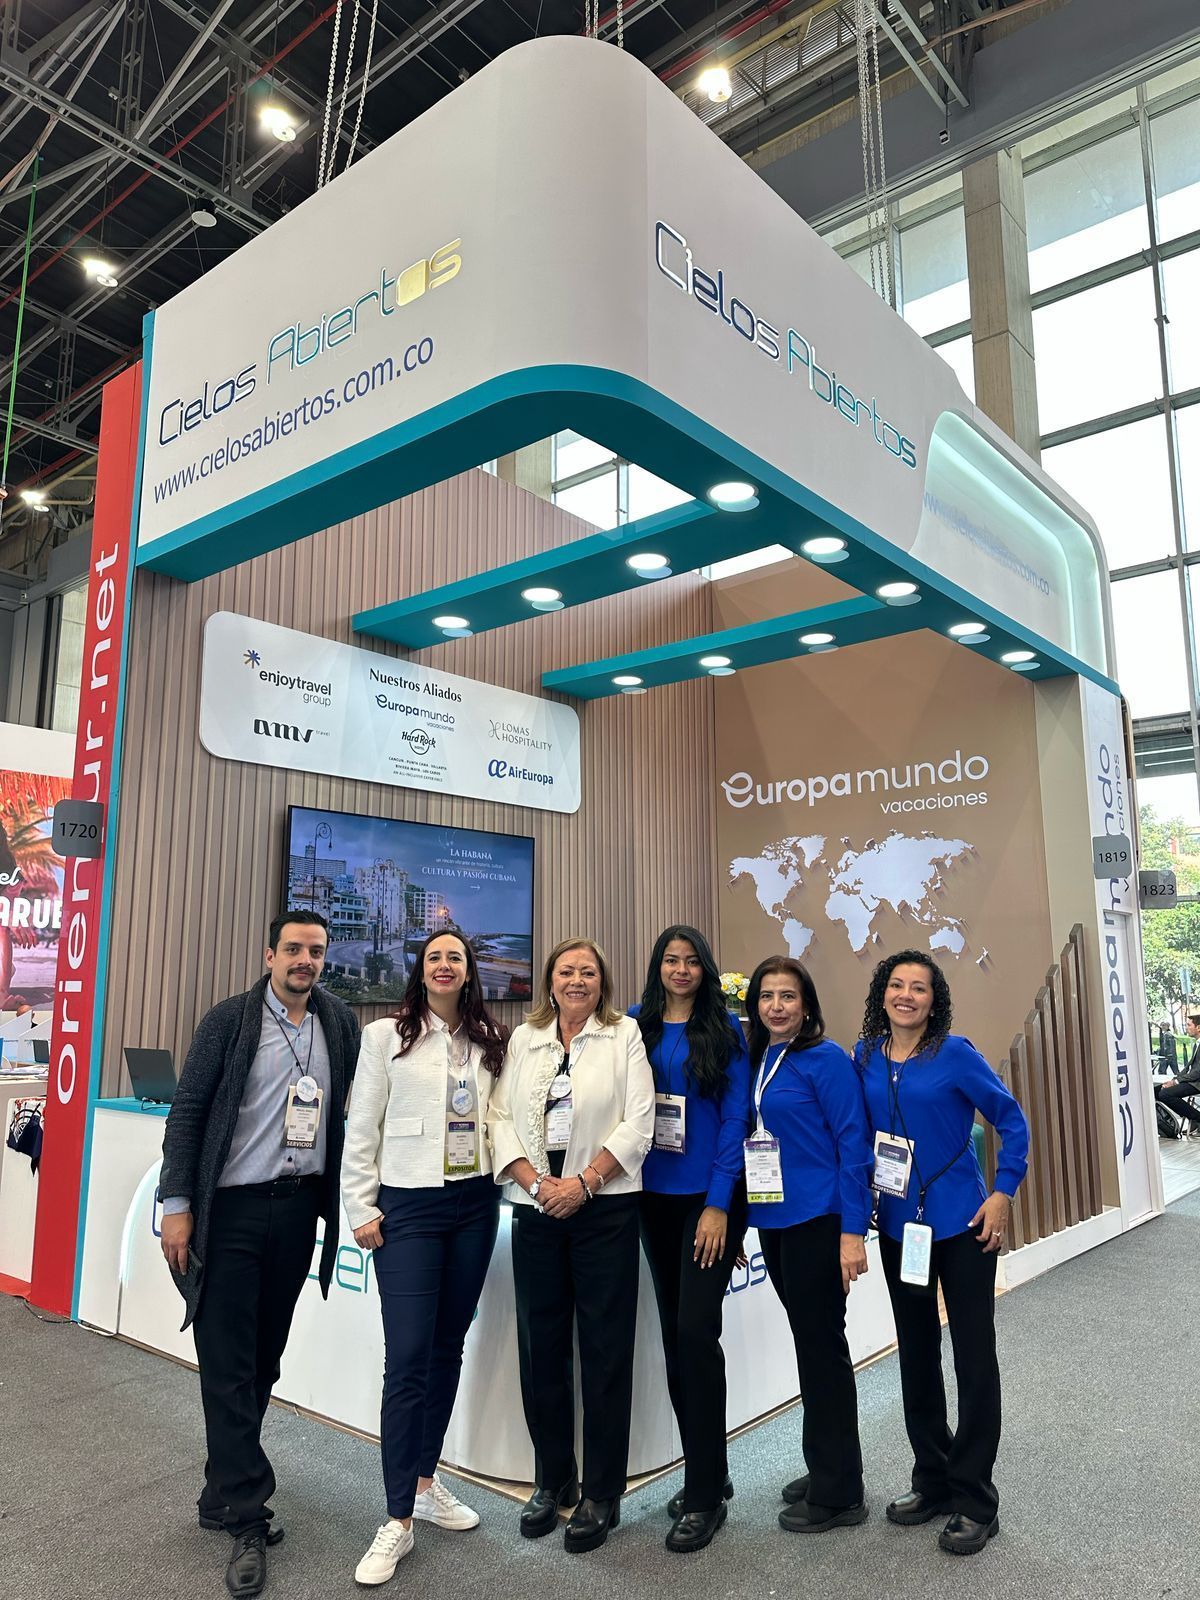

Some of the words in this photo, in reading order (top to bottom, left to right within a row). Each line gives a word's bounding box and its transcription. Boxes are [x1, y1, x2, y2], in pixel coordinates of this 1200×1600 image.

[158, 363, 257, 447] Cielos
[266, 237, 462, 386] Abiertos
[655, 220, 780, 360] Cielos
[787, 327, 917, 470] Abiertos
[153, 336, 434, 503] www.cielosabiertos.com.co
[259, 670, 331, 695] enjoytravel
[369, 667, 420, 692] Nuestros
[423, 682, 462, 703] Aliados
[302, 692, 331, 708] group
[427, 721, 455, 733] vacaciones
[502, 722, 530, 737] LOMAS
[401, 731, 419, 743] Hard
[420, 735, 436, 748] Rock
[502, 732, 553, 752] HOSPITALITY
[880, 791, 988, 814] vacaciones
[57, 543, 119, 1105] orienur.net
[60, 822, 98, 839] 1720
[450, 848, 460, 857] LA
[461, 849, 493, 861] HABANA
[1098, 851, 1128, 864] 1819
[421, 866, 456, 877] CULTURA
[489, 873, 517, 883] CUBANA
[1142, 884, 1175, 897] 1823
[286, 1140, 313, 1148] SERVICIOS
[448, 1165, 475, 1173] EXPOSITOR
[871, 1183, 905, 1198] PROFESIONAL
